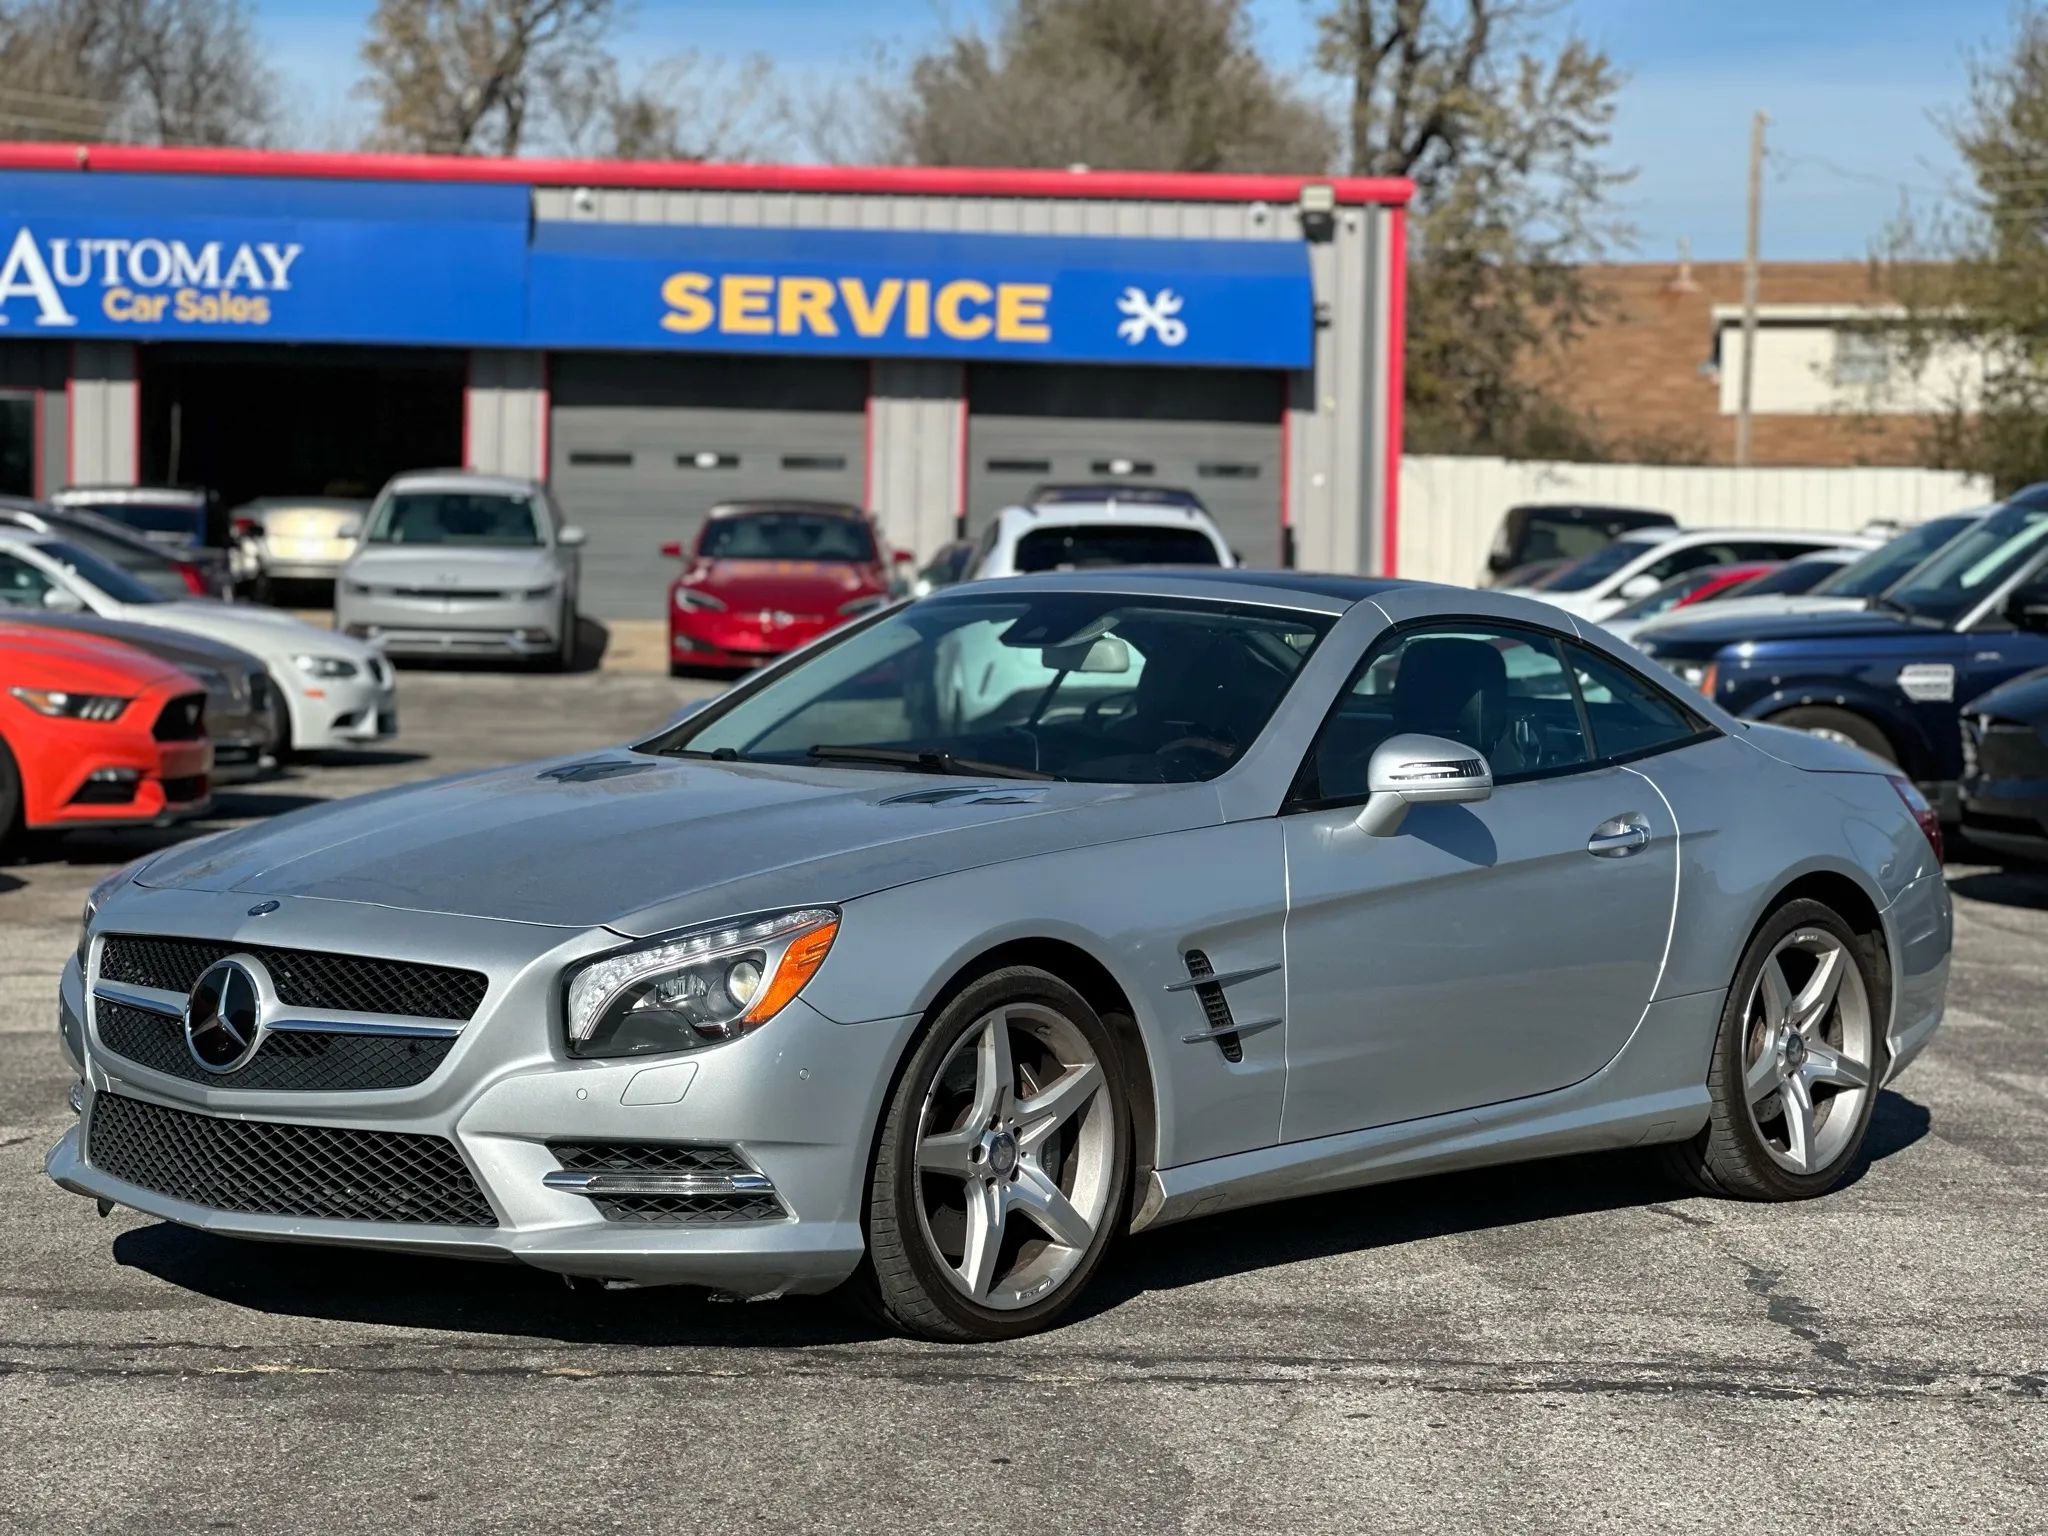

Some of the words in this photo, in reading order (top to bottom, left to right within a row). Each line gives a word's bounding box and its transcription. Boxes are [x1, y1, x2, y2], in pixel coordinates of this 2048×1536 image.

[0, 226, 302, 326] AUTOMAY
[103, 287, 167, 322] Car
[174, 288, 271, 324] Sales
[662, 272, 1051, 343] SERVICE
